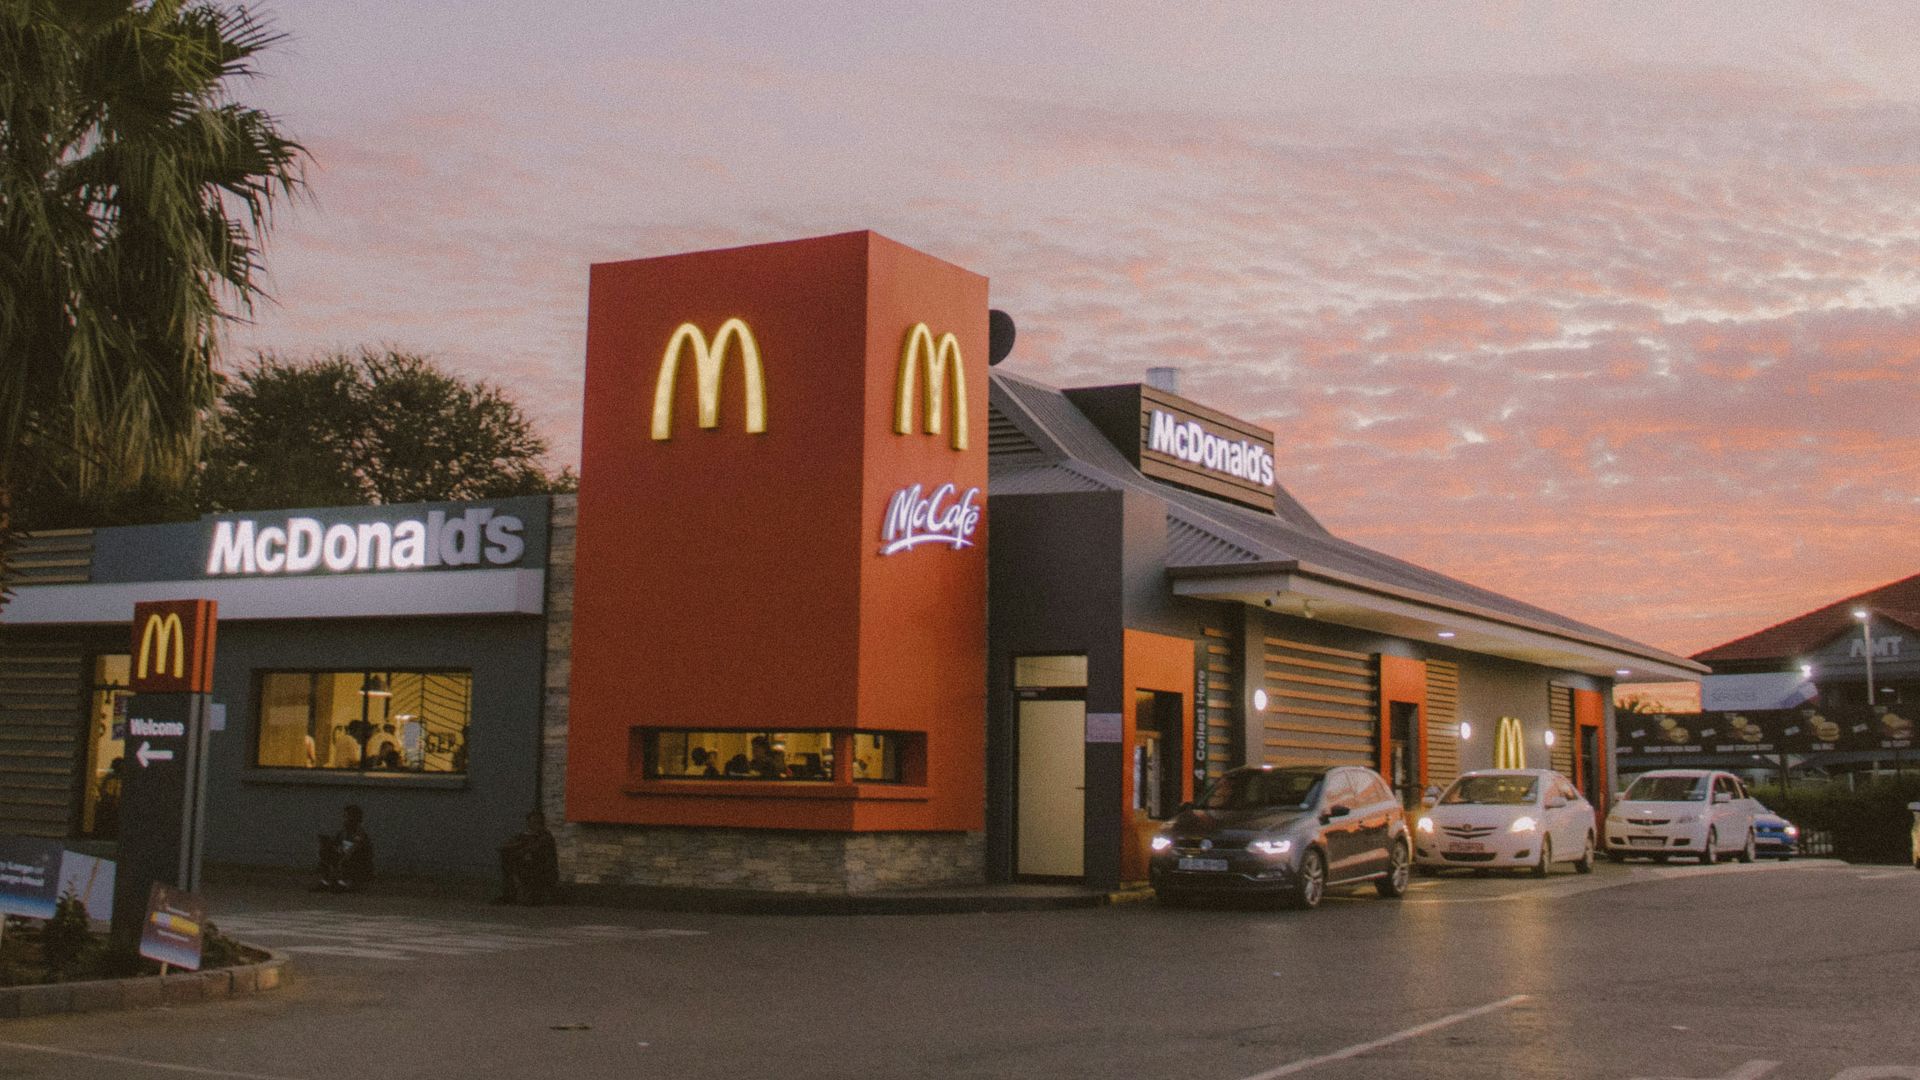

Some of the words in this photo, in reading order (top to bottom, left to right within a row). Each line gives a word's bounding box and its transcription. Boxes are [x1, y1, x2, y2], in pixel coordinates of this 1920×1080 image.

[1150, 409, 1274, 486] McDonald's
[207, 507, 525, 575] McDonald's
[1197, 669, 1206, 704] Here
[130, 718, 185, 736] Welcome
[1196, 709, 1206, 760] Collect
